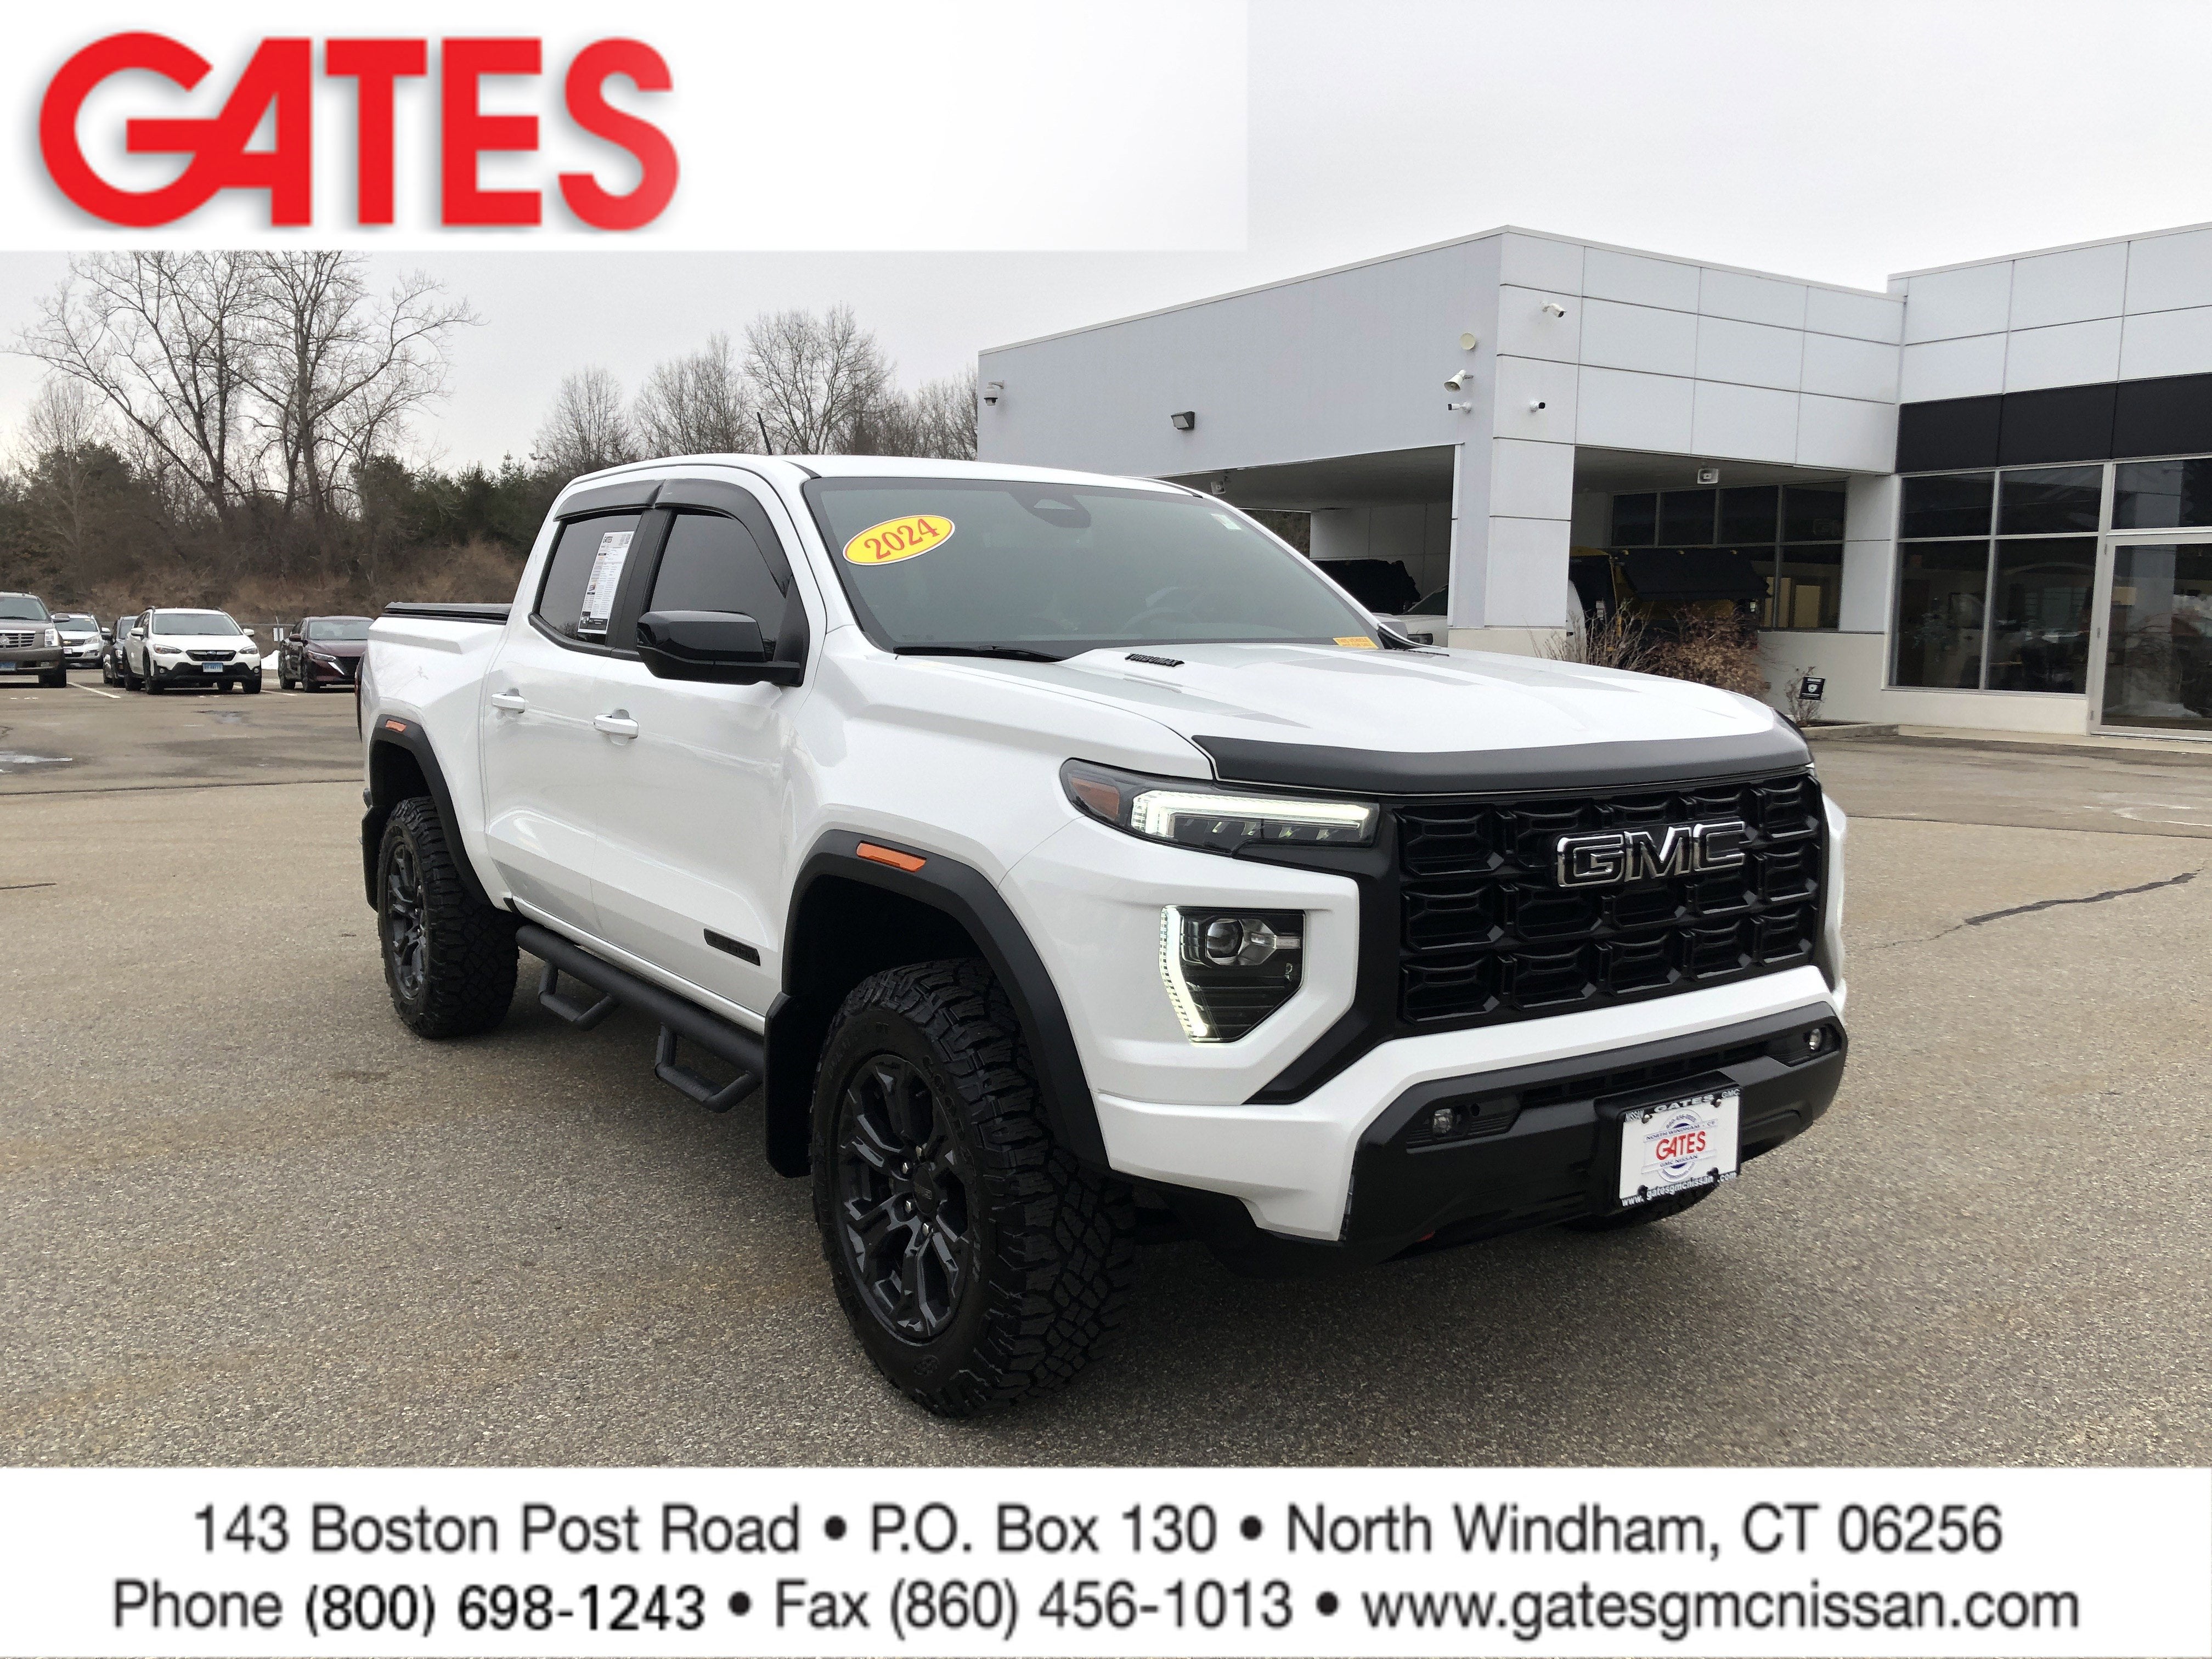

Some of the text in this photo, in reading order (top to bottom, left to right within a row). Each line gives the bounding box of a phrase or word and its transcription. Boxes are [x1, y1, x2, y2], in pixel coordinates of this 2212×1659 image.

[864, 518, 940, 560] 2024
[1557, 821, 1746, 887] GMC
[1654, 1094, 1715, 1113] GATES
[1721, 1088, 1741, 1099] GMC
[1656, 1130, 1706, 1161] GATES
